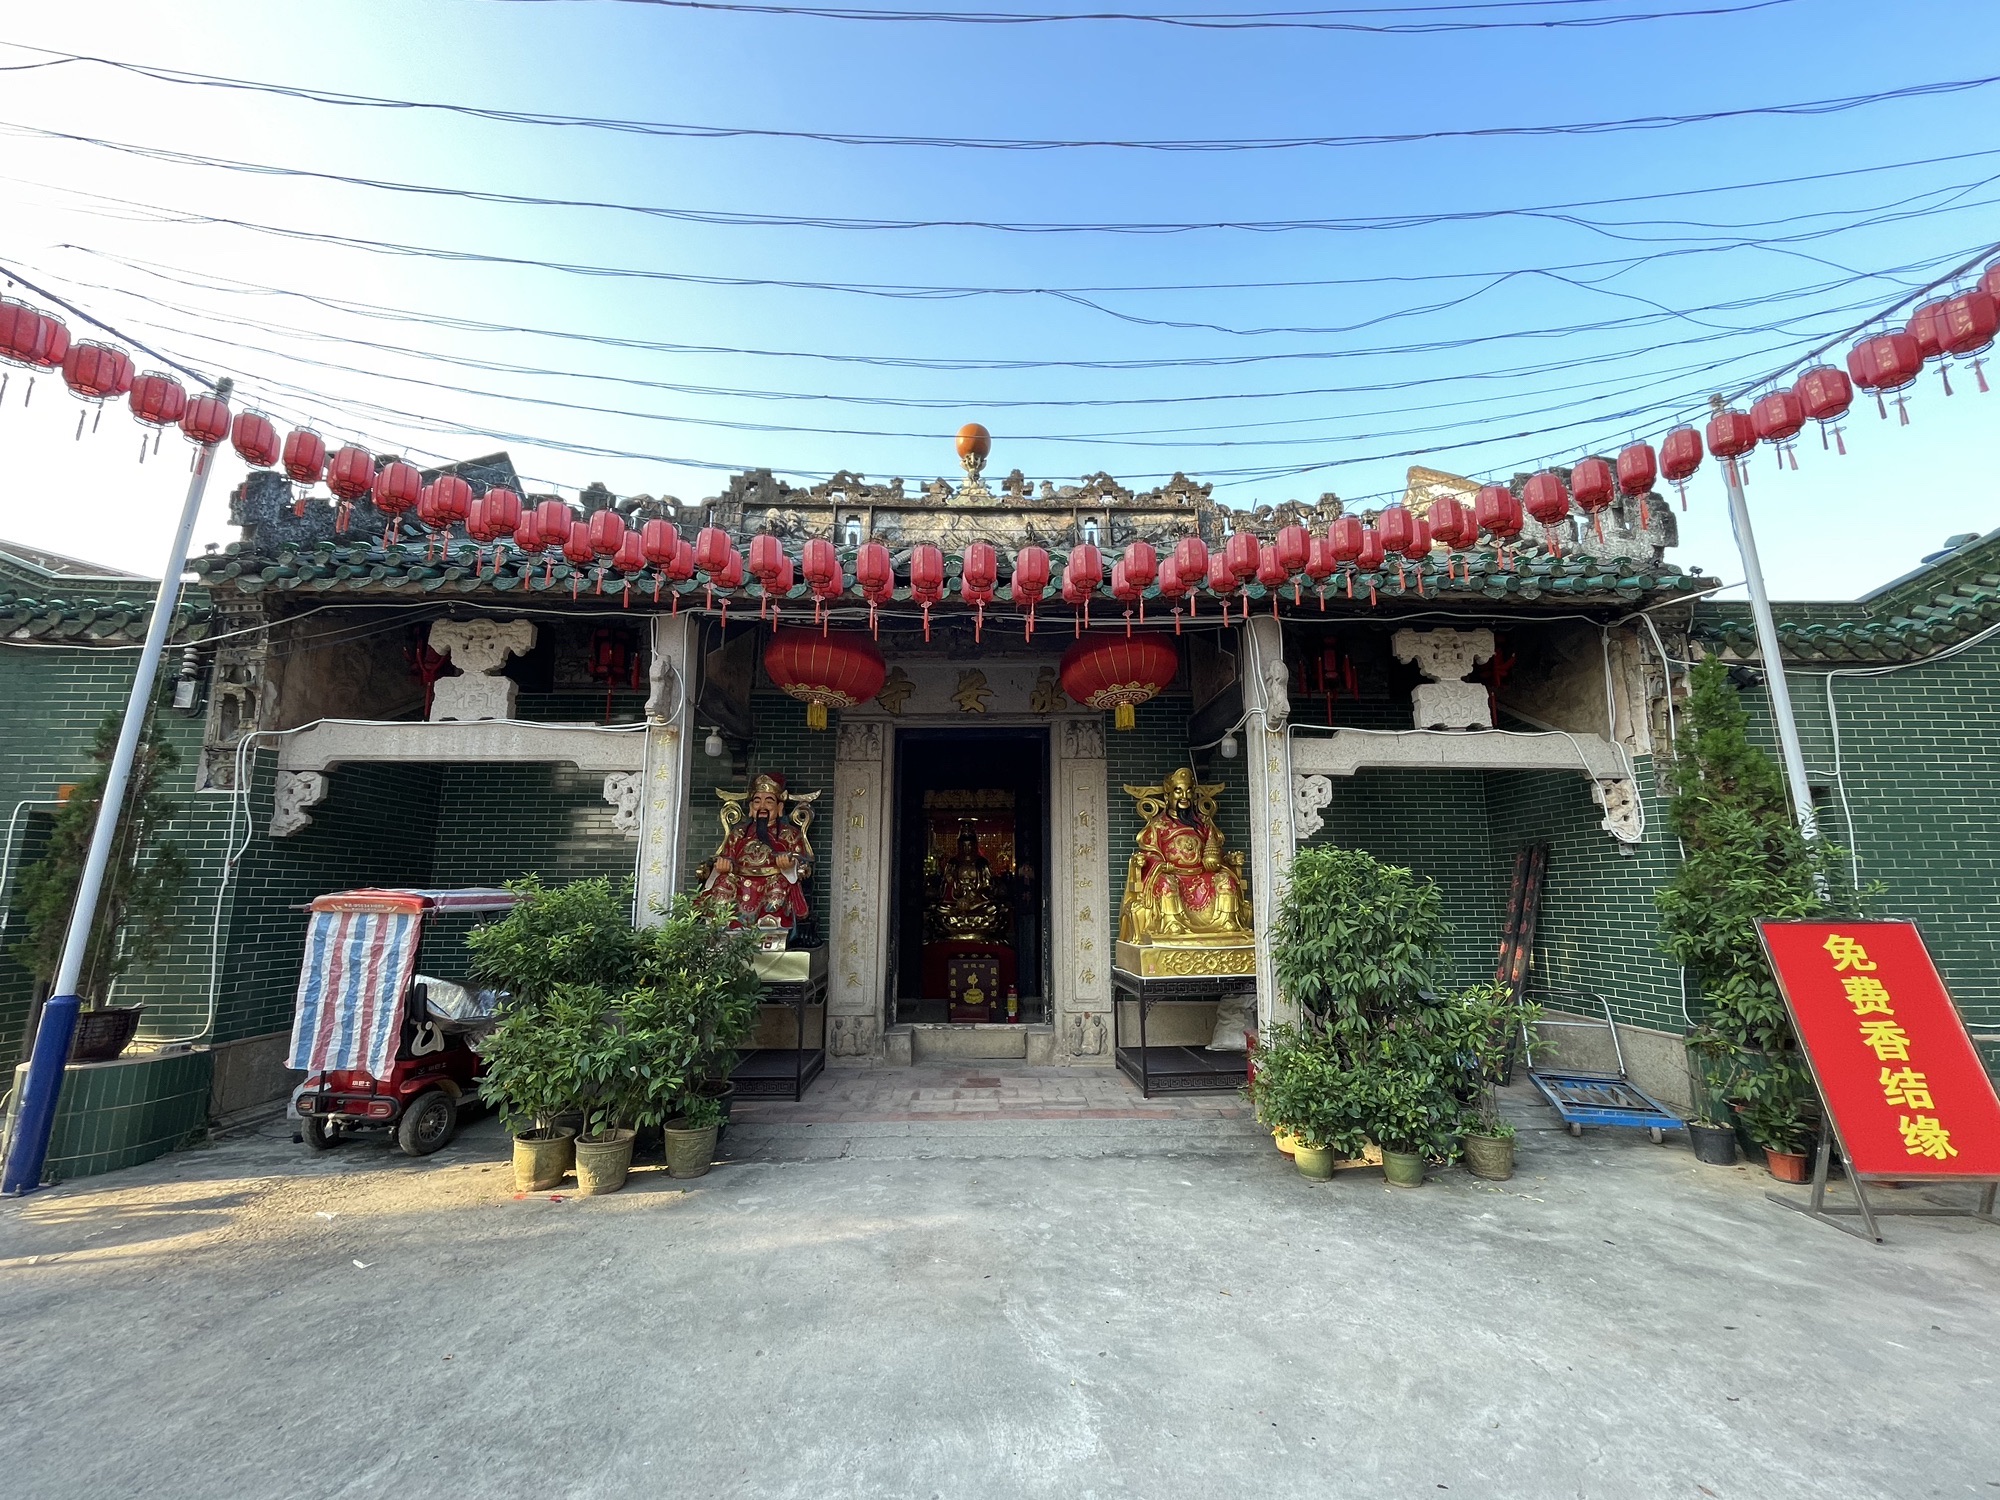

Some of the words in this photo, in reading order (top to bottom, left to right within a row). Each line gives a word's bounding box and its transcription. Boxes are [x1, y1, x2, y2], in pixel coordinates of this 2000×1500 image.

[1823, 933, 1959, 1161] 免费香结缘
